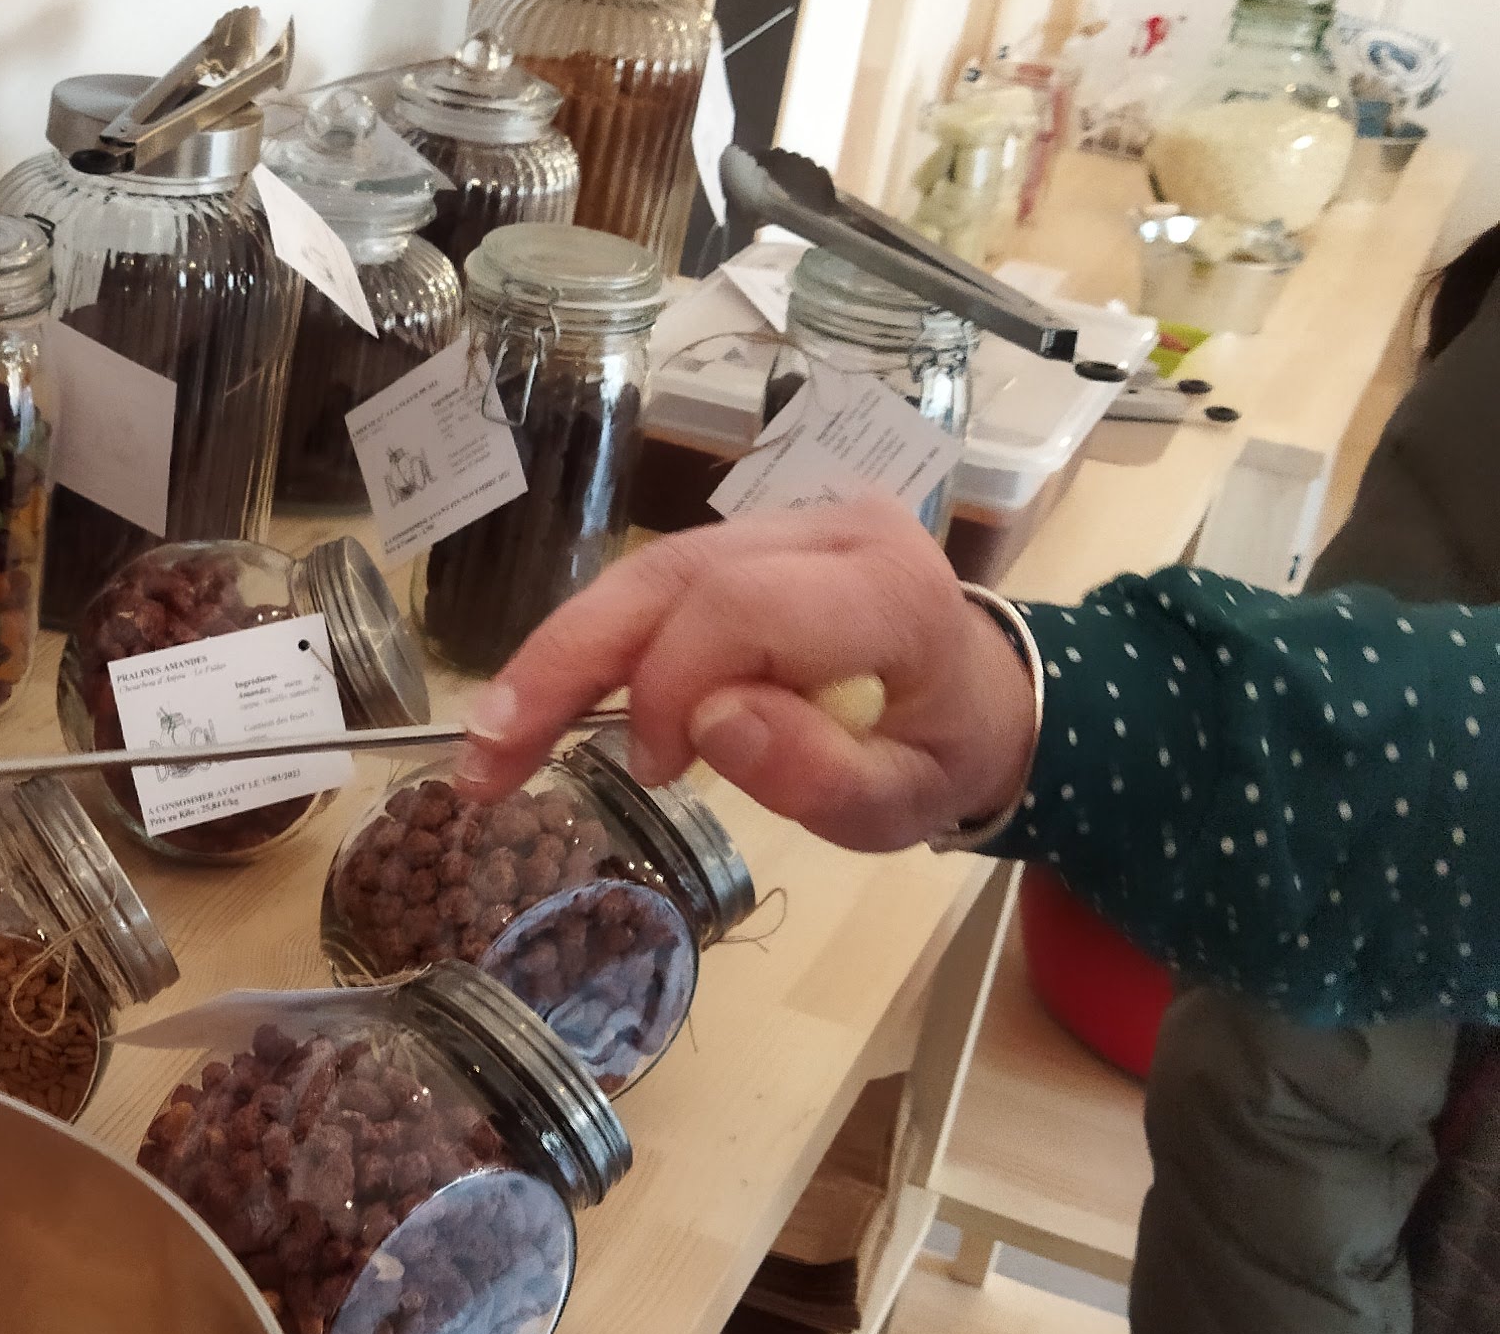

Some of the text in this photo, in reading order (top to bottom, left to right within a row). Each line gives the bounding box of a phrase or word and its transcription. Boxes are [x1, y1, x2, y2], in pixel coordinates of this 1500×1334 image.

[116, 666, 162, 685] PRALINES
[163, 654, 209, 673] AMANDES
[155, 791, 214, 814] CONSOMMER
[216, 782, 247, 798] AVANT
